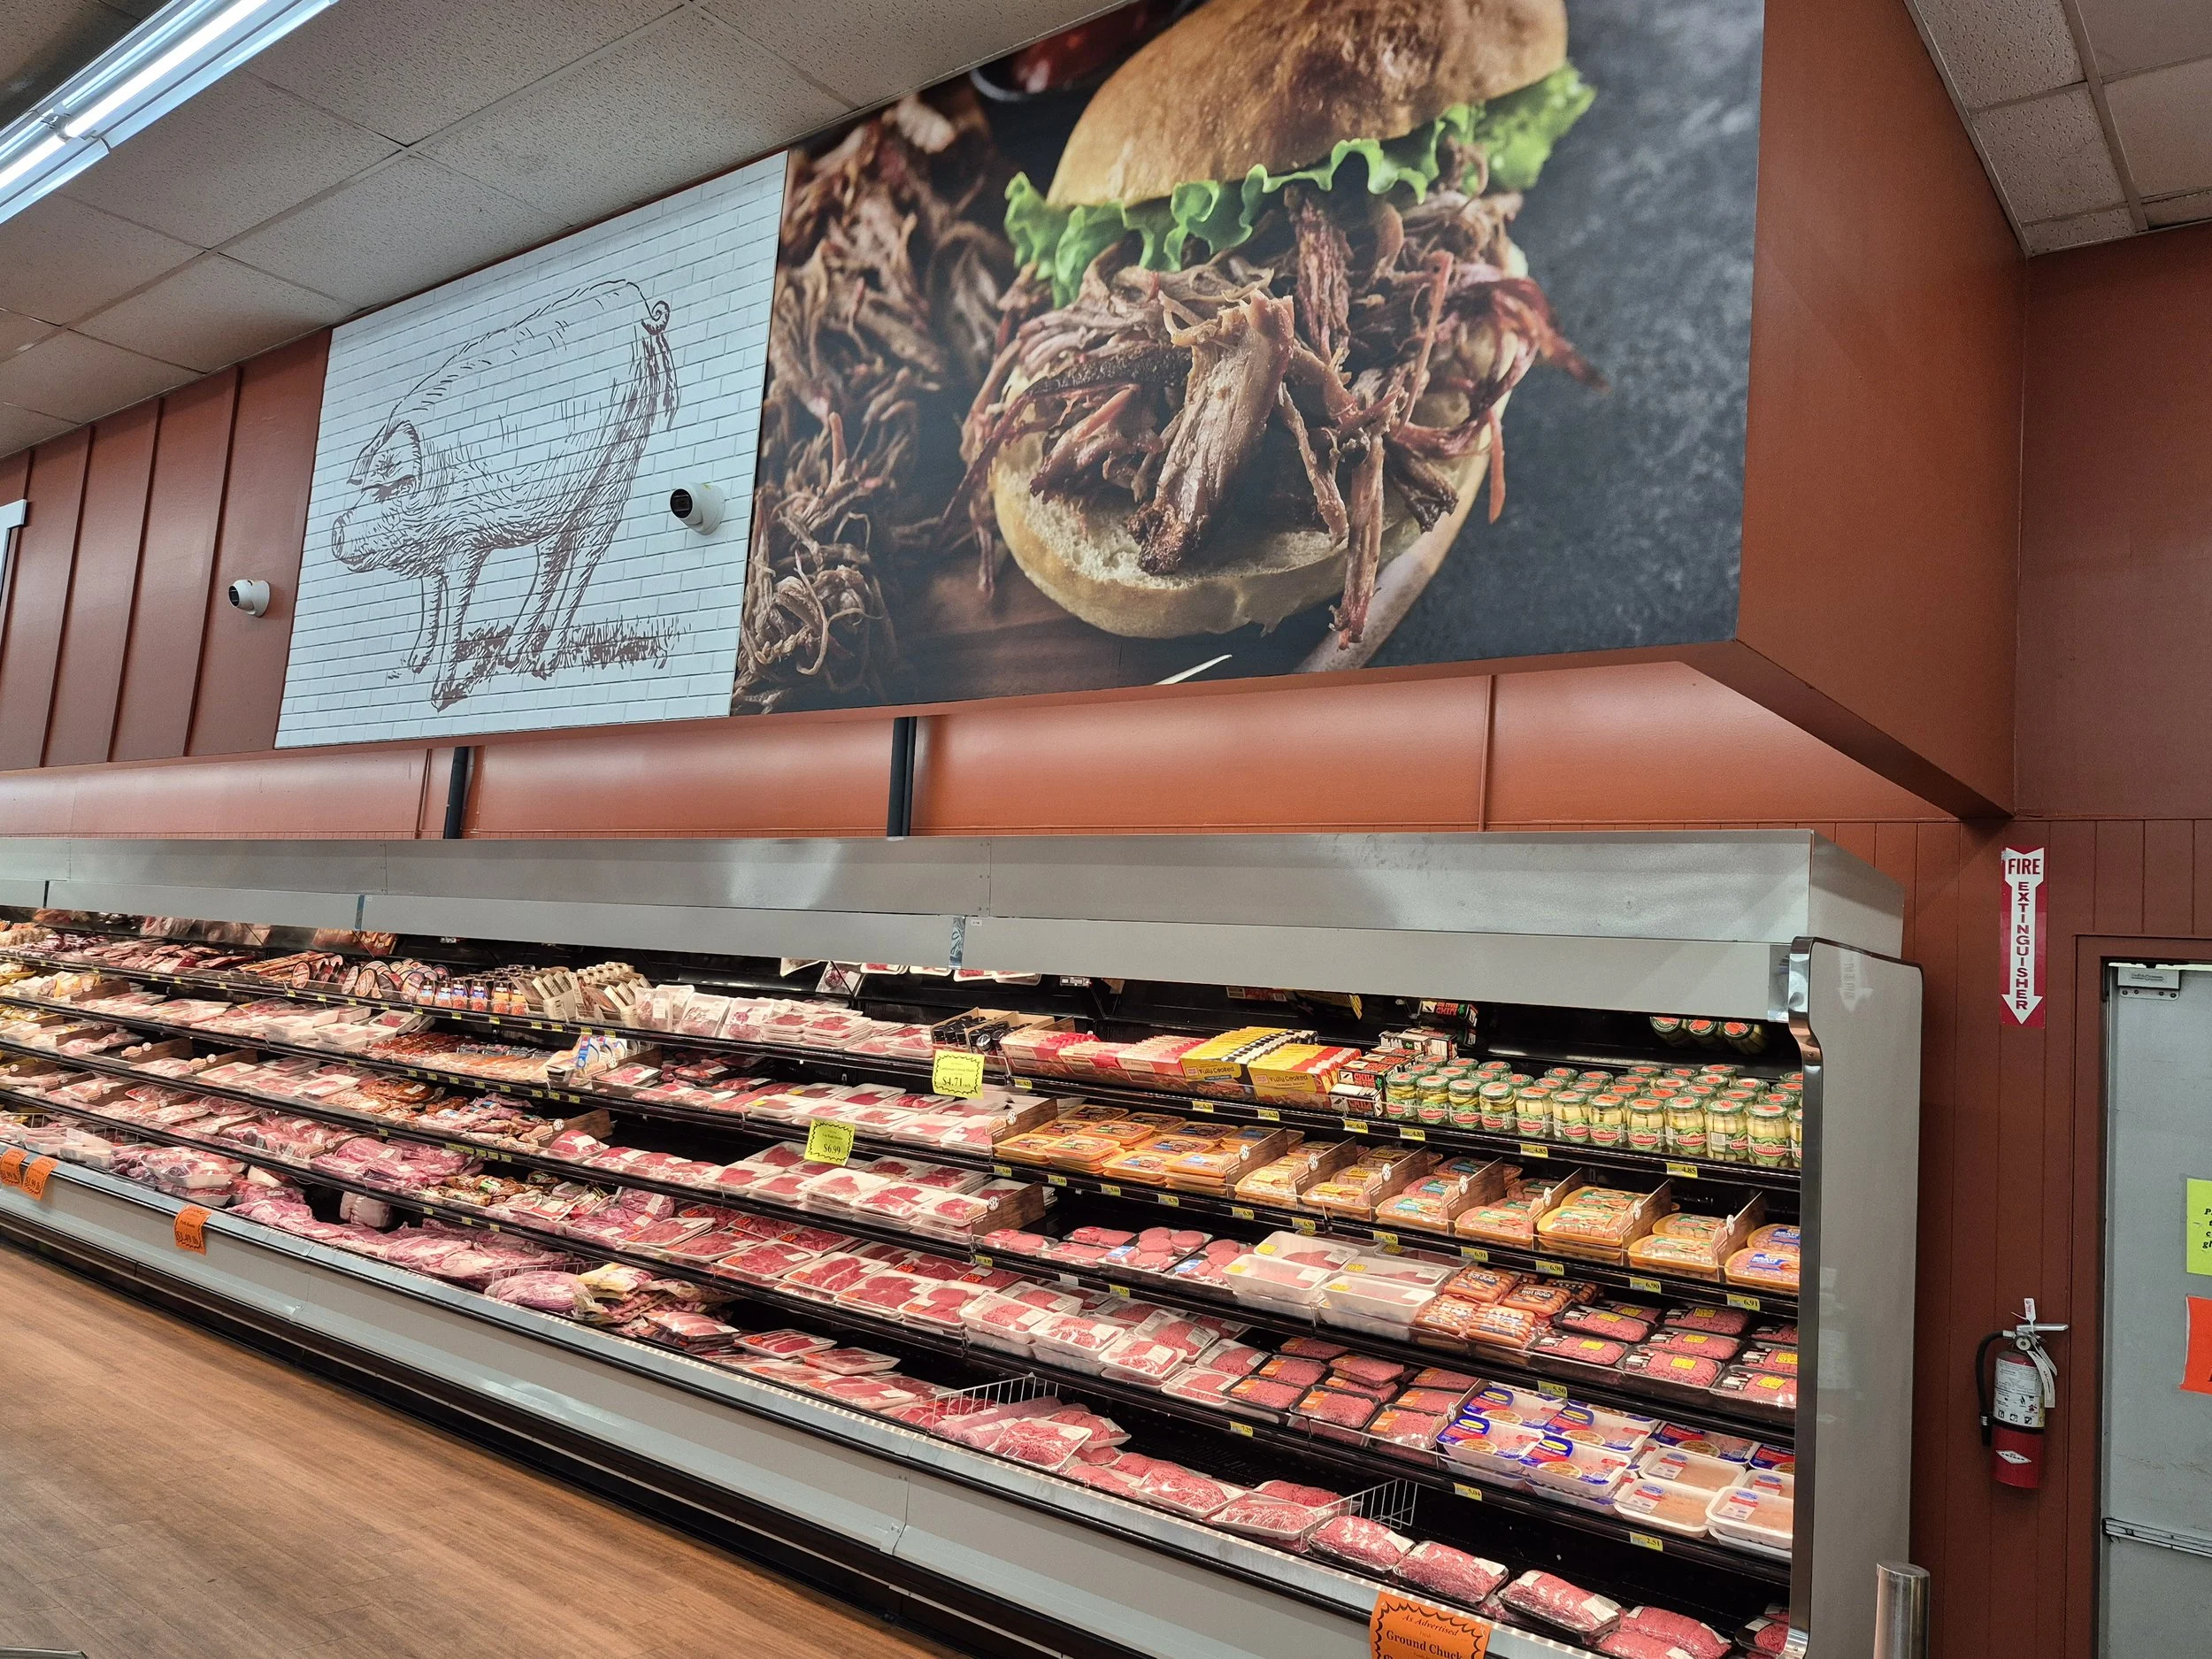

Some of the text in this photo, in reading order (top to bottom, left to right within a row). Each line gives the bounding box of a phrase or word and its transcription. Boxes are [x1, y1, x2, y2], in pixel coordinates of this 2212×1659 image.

[2008, 857, 2041, 876] FIRE
[2015, 881, 2032, 1010] EXTINGUISHER
[942, 1076, 963, 1087] $4.71
[824, 1144, 841, 1155] $6.99
[1647, 1538, 1661, 1547] 2.51
[1415, 1618, 1459, 1636] Advertised
[1386, 1630, 1462, 1659] Ground Chuck
